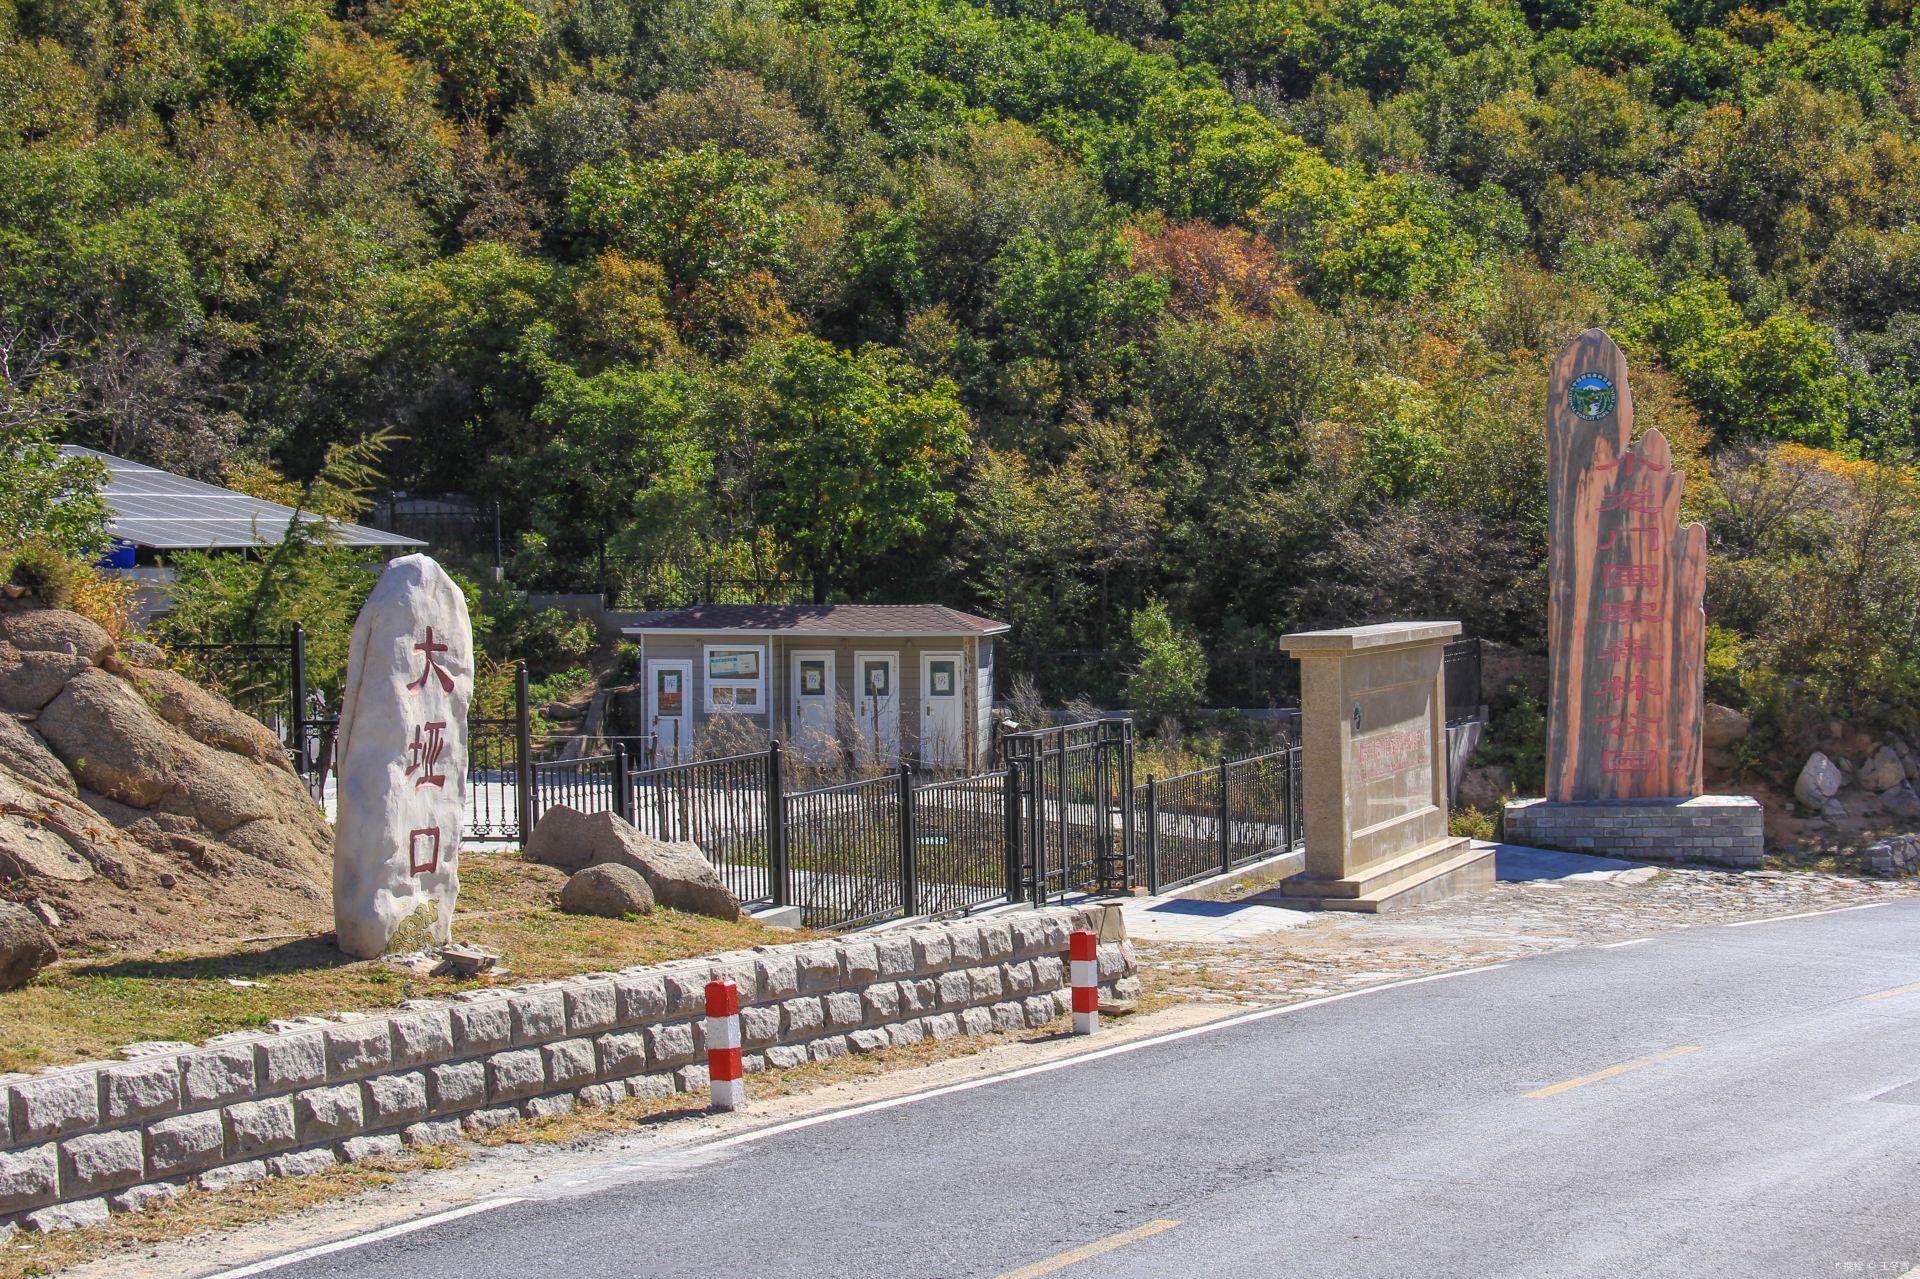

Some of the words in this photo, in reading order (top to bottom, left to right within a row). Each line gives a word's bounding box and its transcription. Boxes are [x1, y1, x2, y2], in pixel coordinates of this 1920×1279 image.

[405, 626, 455, 876] 大垭口
[1594, 451, 1665, 773] 小龙门国家森林公园
